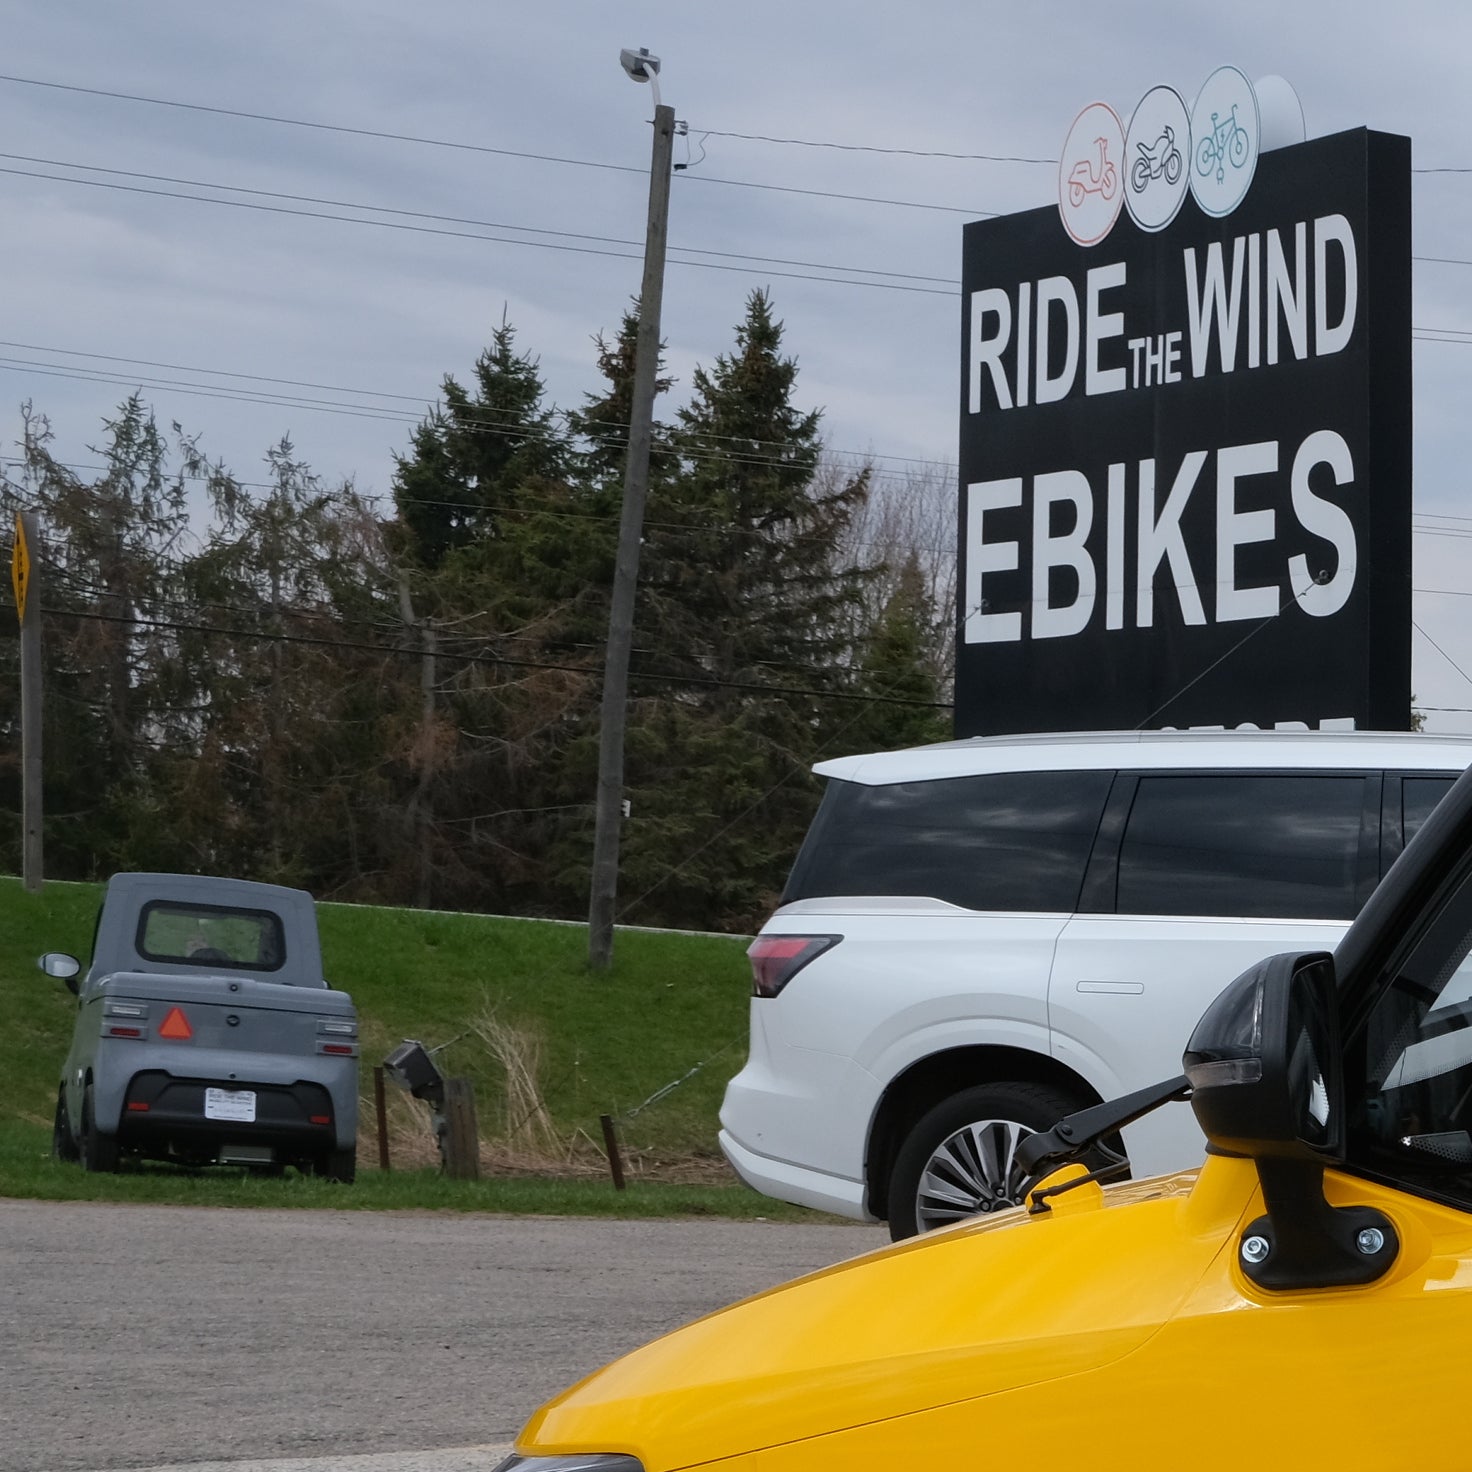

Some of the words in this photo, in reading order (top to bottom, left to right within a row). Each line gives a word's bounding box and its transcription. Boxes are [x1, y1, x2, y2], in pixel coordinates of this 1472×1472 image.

[969, 262, 1126, 413] RIDE
[1128, 331, 1182, 388] THE
[1184, 214, 1357, 378] WIND
[965, 430, 1356, 643] EBIKES
